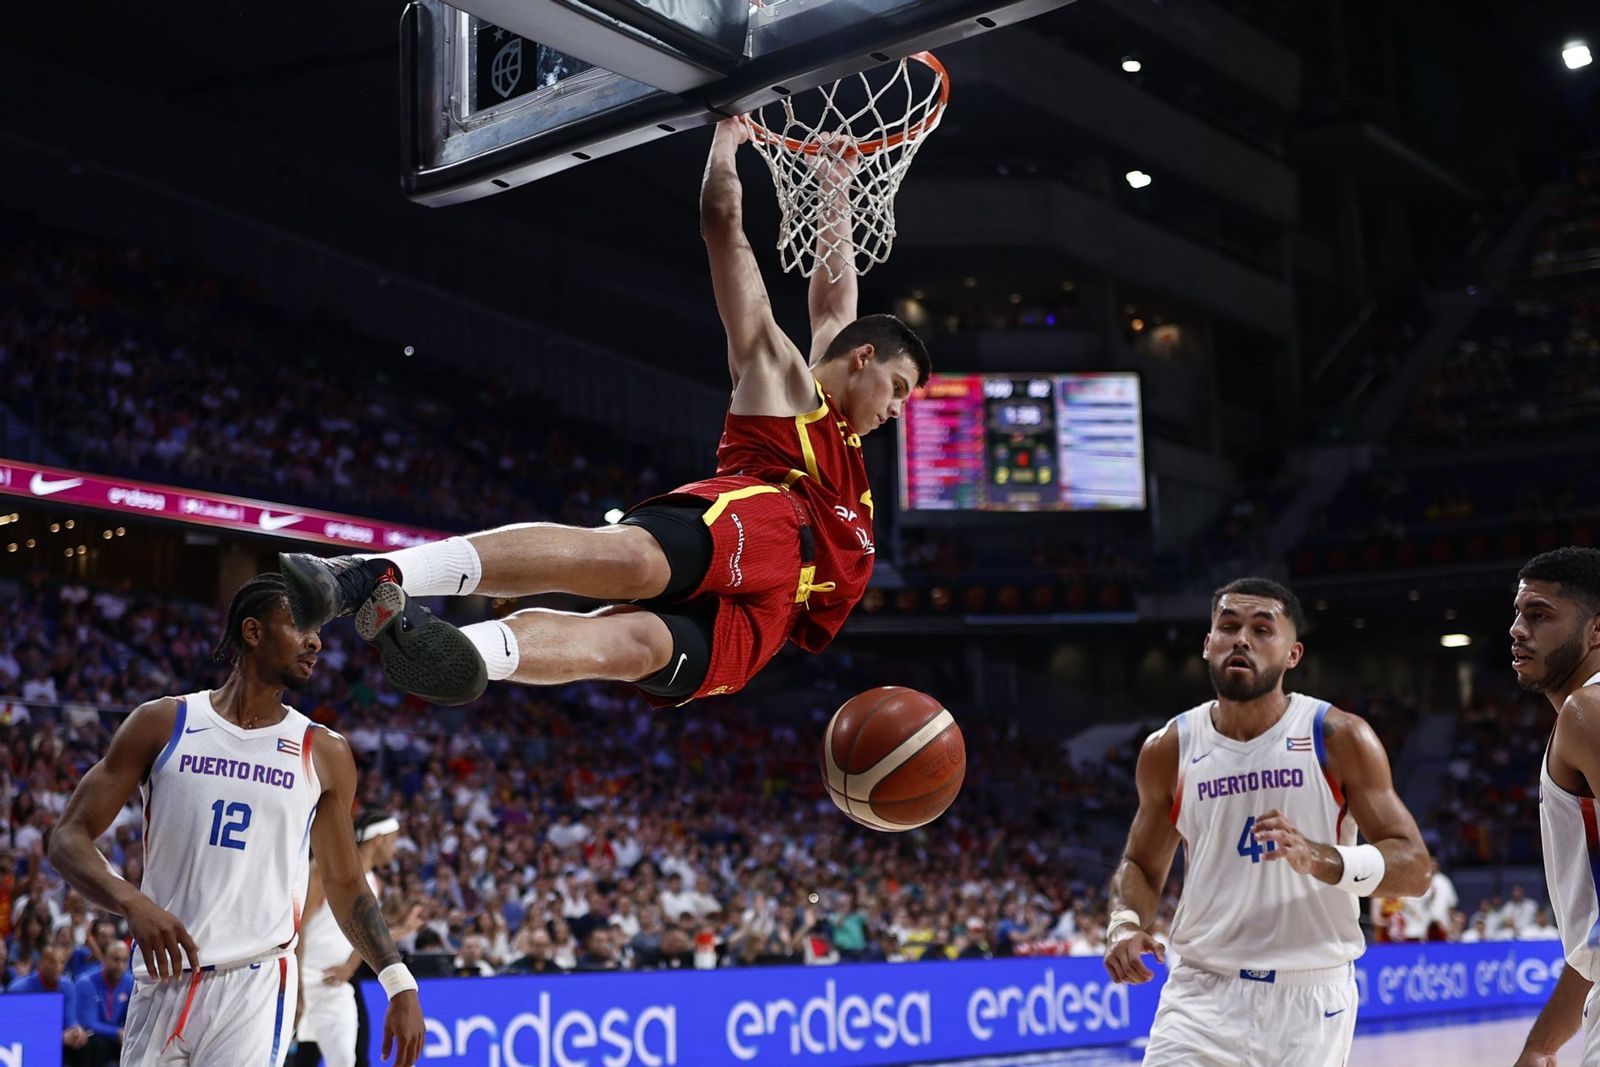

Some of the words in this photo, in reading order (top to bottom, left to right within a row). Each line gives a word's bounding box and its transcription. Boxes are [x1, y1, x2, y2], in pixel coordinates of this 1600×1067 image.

[179, 754, 251, 780] PUERTO
[252, 764, 295, 789] RICO
[1197, 772, 1260, 801] PUERTO
[1261, 768, 1304, 789] RICO
[209, 799, 252, 850] 12
[967, 967, 1130, 1041] endesa
[1378, 952, 1468, 1005] endesa
[726, 978, 931, 1060] endesa
